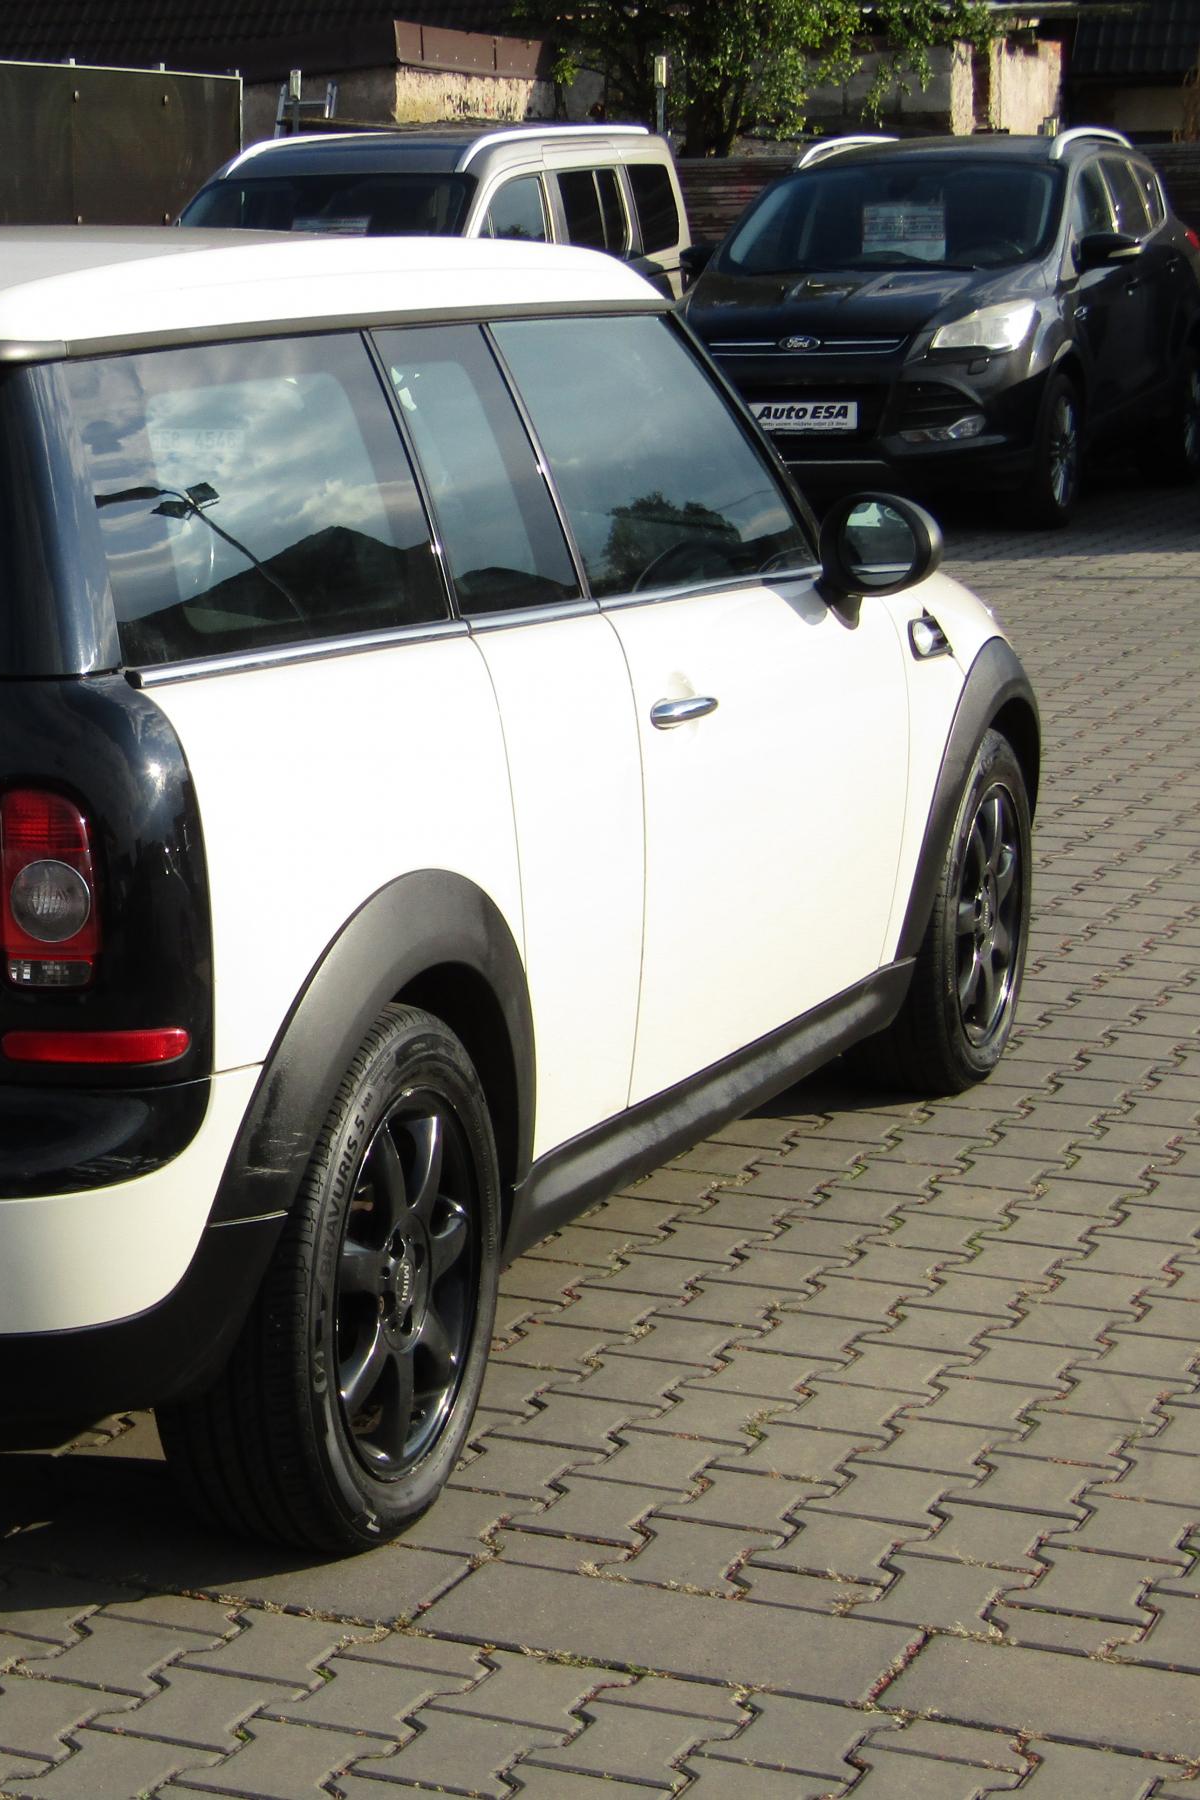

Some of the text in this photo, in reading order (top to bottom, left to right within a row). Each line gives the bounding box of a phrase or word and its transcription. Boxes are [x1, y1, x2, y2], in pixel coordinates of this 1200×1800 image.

[786, 335, 810, 348] Ford
[757, 405, 849, 420] Auto ESA
[319, 1135, 358, 1278] BRAVURIS
[354, 1115, 366, 1135] 5
[401, 1265, 410, 1301] MINI
